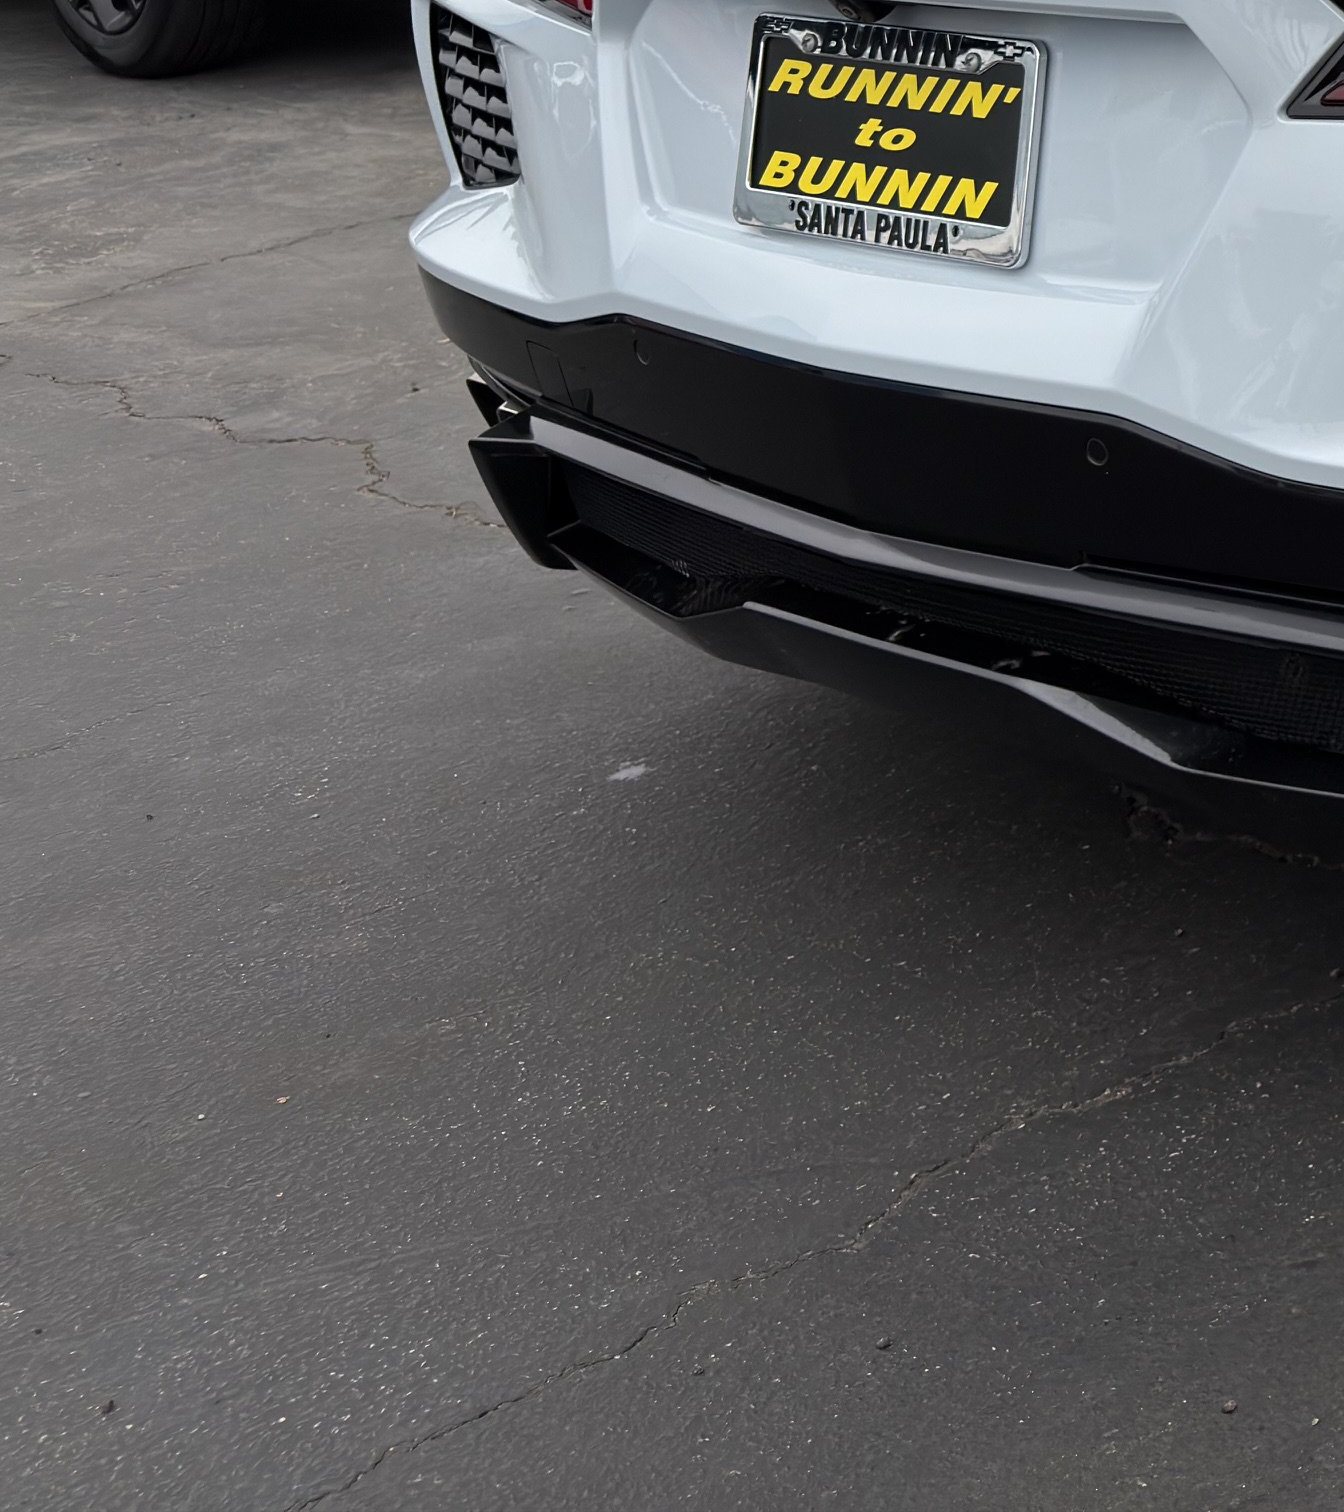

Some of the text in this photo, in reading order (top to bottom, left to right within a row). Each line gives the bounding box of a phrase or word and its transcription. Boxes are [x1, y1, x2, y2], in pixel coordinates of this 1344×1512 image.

[821, 22, 963, 69] BUNNIN
[768, 59, 1021, 119] RUNNIN'
[854, 119, 917, 151] to
[759, 150, 999, 219] BUNNIN
[795, 201, 950, 254] SANTA PAULA
